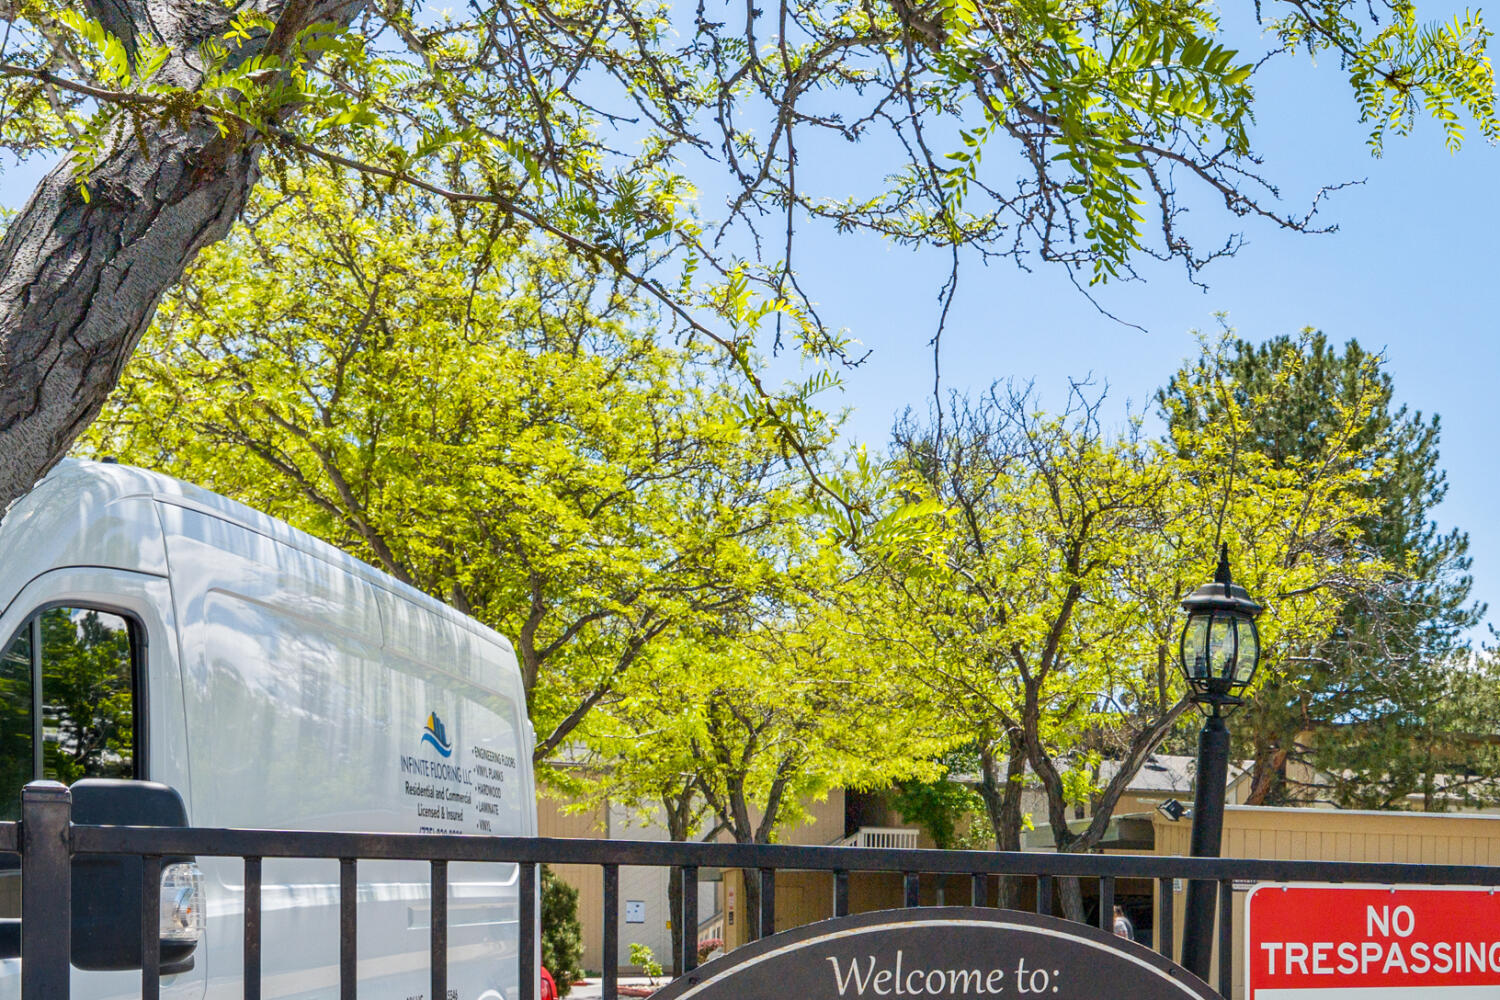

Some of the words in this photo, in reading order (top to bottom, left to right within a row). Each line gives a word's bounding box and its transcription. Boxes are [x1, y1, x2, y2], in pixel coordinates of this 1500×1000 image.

[400, 755, 429, 777] INFINITE
[430, 761, 462, 783] FLOORING
[463, 768, 472, 785] LLC
[405, 780, 434, 799] Residential
[436, 786, 445, 800] and
[446, 788, 472, 804] Commercial
[417, 802, 440, 819] Licensed
[446, 807, 463, 821] Insured
[1366, 904, 1415, 937] NO
[825, 950, 1004, 996] Welcome
[1015, 957, 1060, 994] to:
